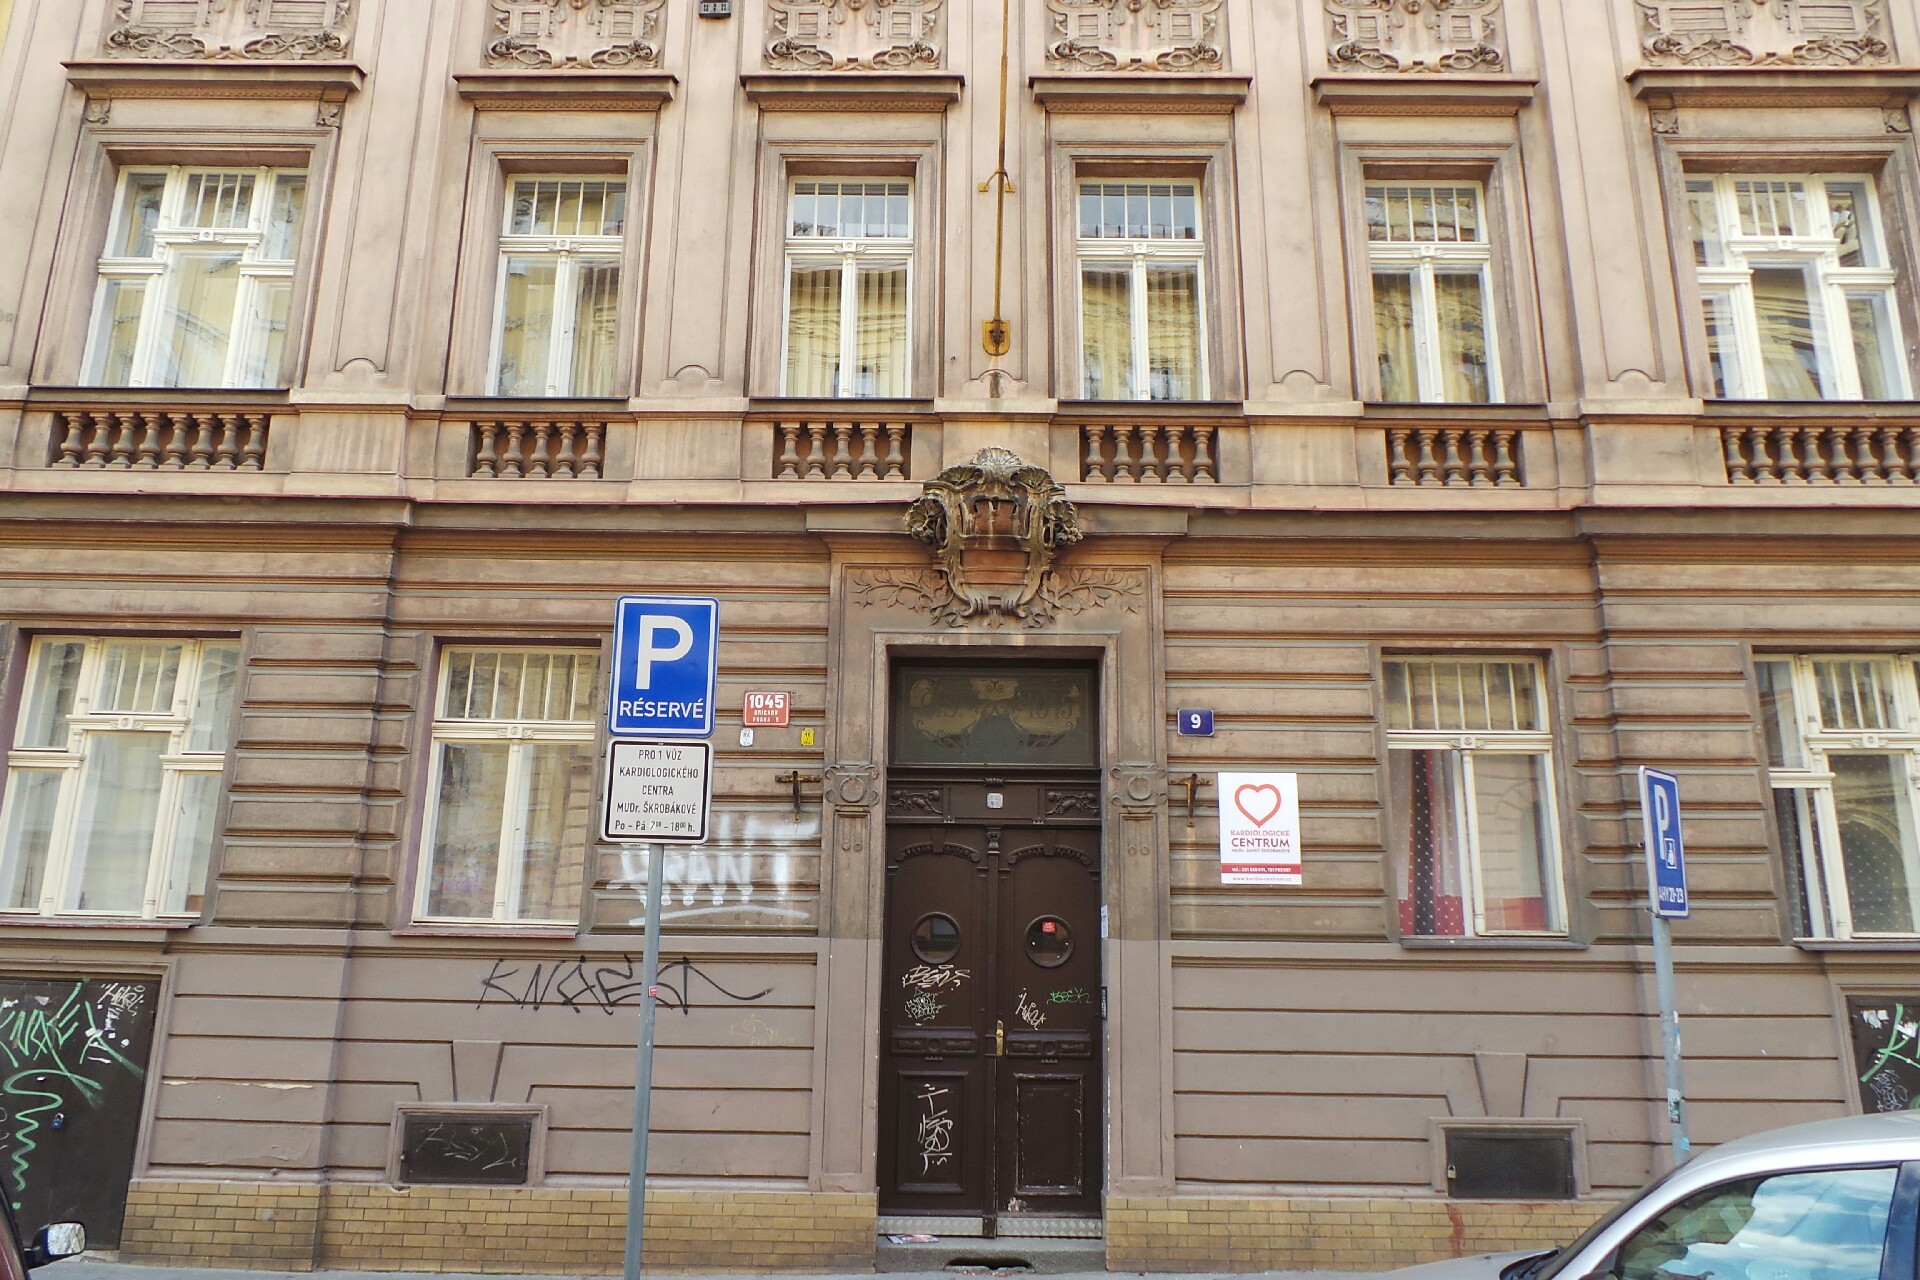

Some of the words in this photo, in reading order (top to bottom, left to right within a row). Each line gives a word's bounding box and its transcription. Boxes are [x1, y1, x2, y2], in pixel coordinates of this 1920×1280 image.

[636, 614, 694, 690] P
[619, 698, 704, 719] RÉSERVÉ
[749, 694, 785, 709] 1045
[1190, 713, 1202, 729] 9
[638, 749, 656, 760] PRO
[658, 750, 662, 760] 1
[619, 766, 699, 779] KARDIOLOGICKÉHO
[642, 785, 674, 795] CENTRA
[616, 802, 641, 813] MUDr.
[643, 801, 696, 815] ŠKROBÁKOVÉ
[615, 820, 625, 830] Po
[635, 820, 646, 831] Pá
[1654, 783, 1669, 860] P
[1231, 838, 1290, 848] CENTRUM
